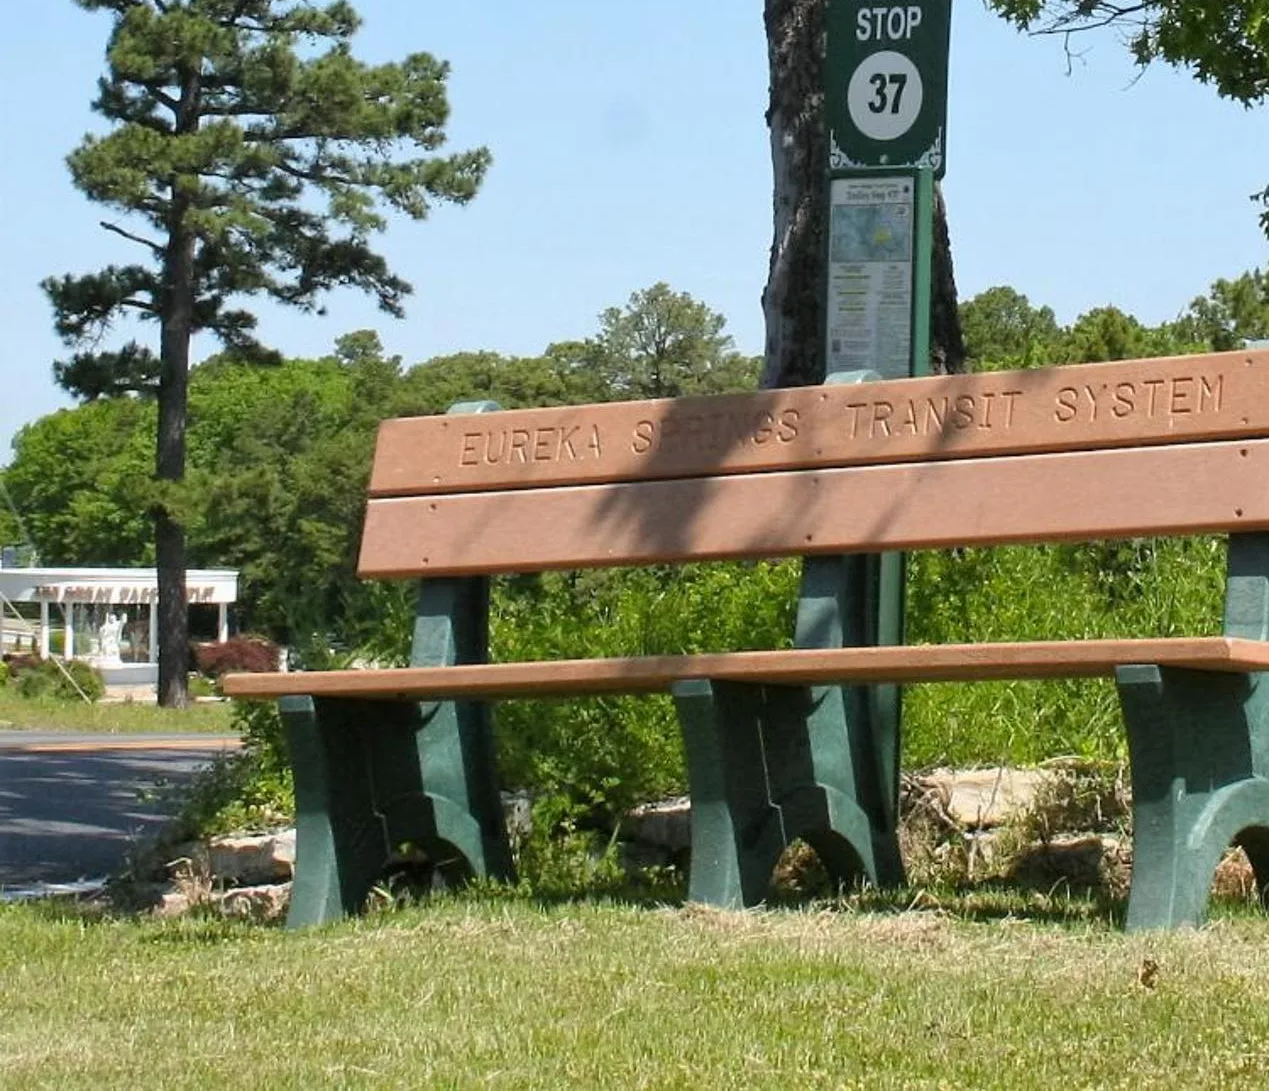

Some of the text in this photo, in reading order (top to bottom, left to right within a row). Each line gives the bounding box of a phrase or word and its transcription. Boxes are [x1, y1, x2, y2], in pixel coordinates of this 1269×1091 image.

[856, 6, 922, 41] STOP
[868, 73, 907, 114] 37
[460, 423, 601, 468] EUREKA
[845, 390, 1024, 440] TRANSIT
[1054, 373, 1225, 423] SYSTEM
